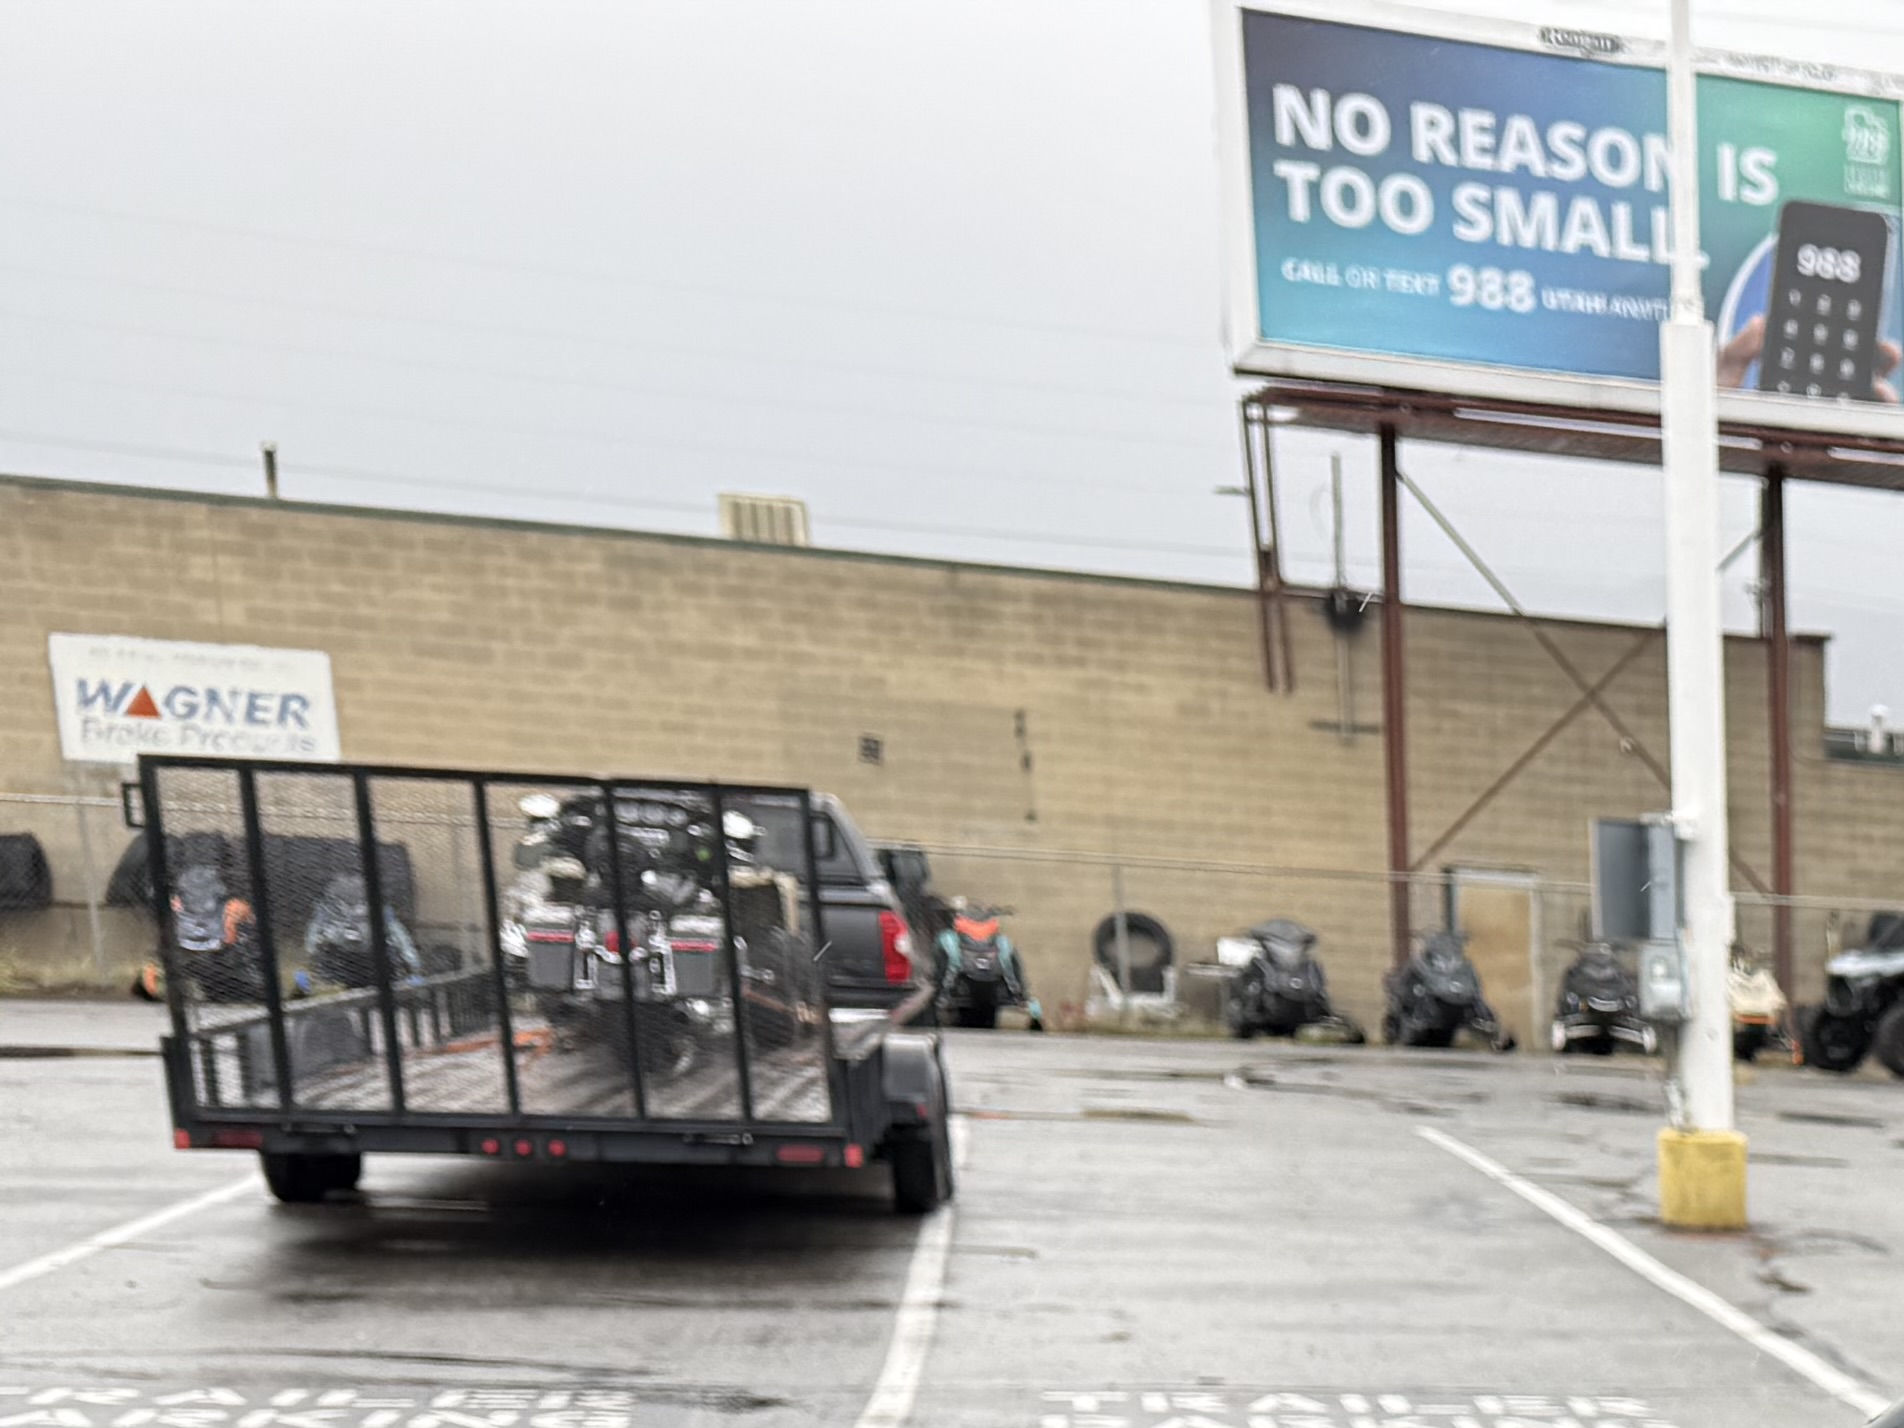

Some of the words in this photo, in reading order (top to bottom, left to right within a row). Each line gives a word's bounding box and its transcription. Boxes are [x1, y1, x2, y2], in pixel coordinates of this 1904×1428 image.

[1273, 83, 1391, 156] NO
[1717, 143, 1779, 205] IS
[1273, 159, 1435, 235] TOO
[1281, 257, 1341, 287] CALL
[1346, 264, 1379, 290] OR
[1384, 268, 1440, 296] TEXT
[1448, 263, 1536, 313] 988
[1797, 243, 1861, 283] 988
[76, 677, 311, 730] WAGNER
[1042, 1389, 1655, 1416] TRAILER
